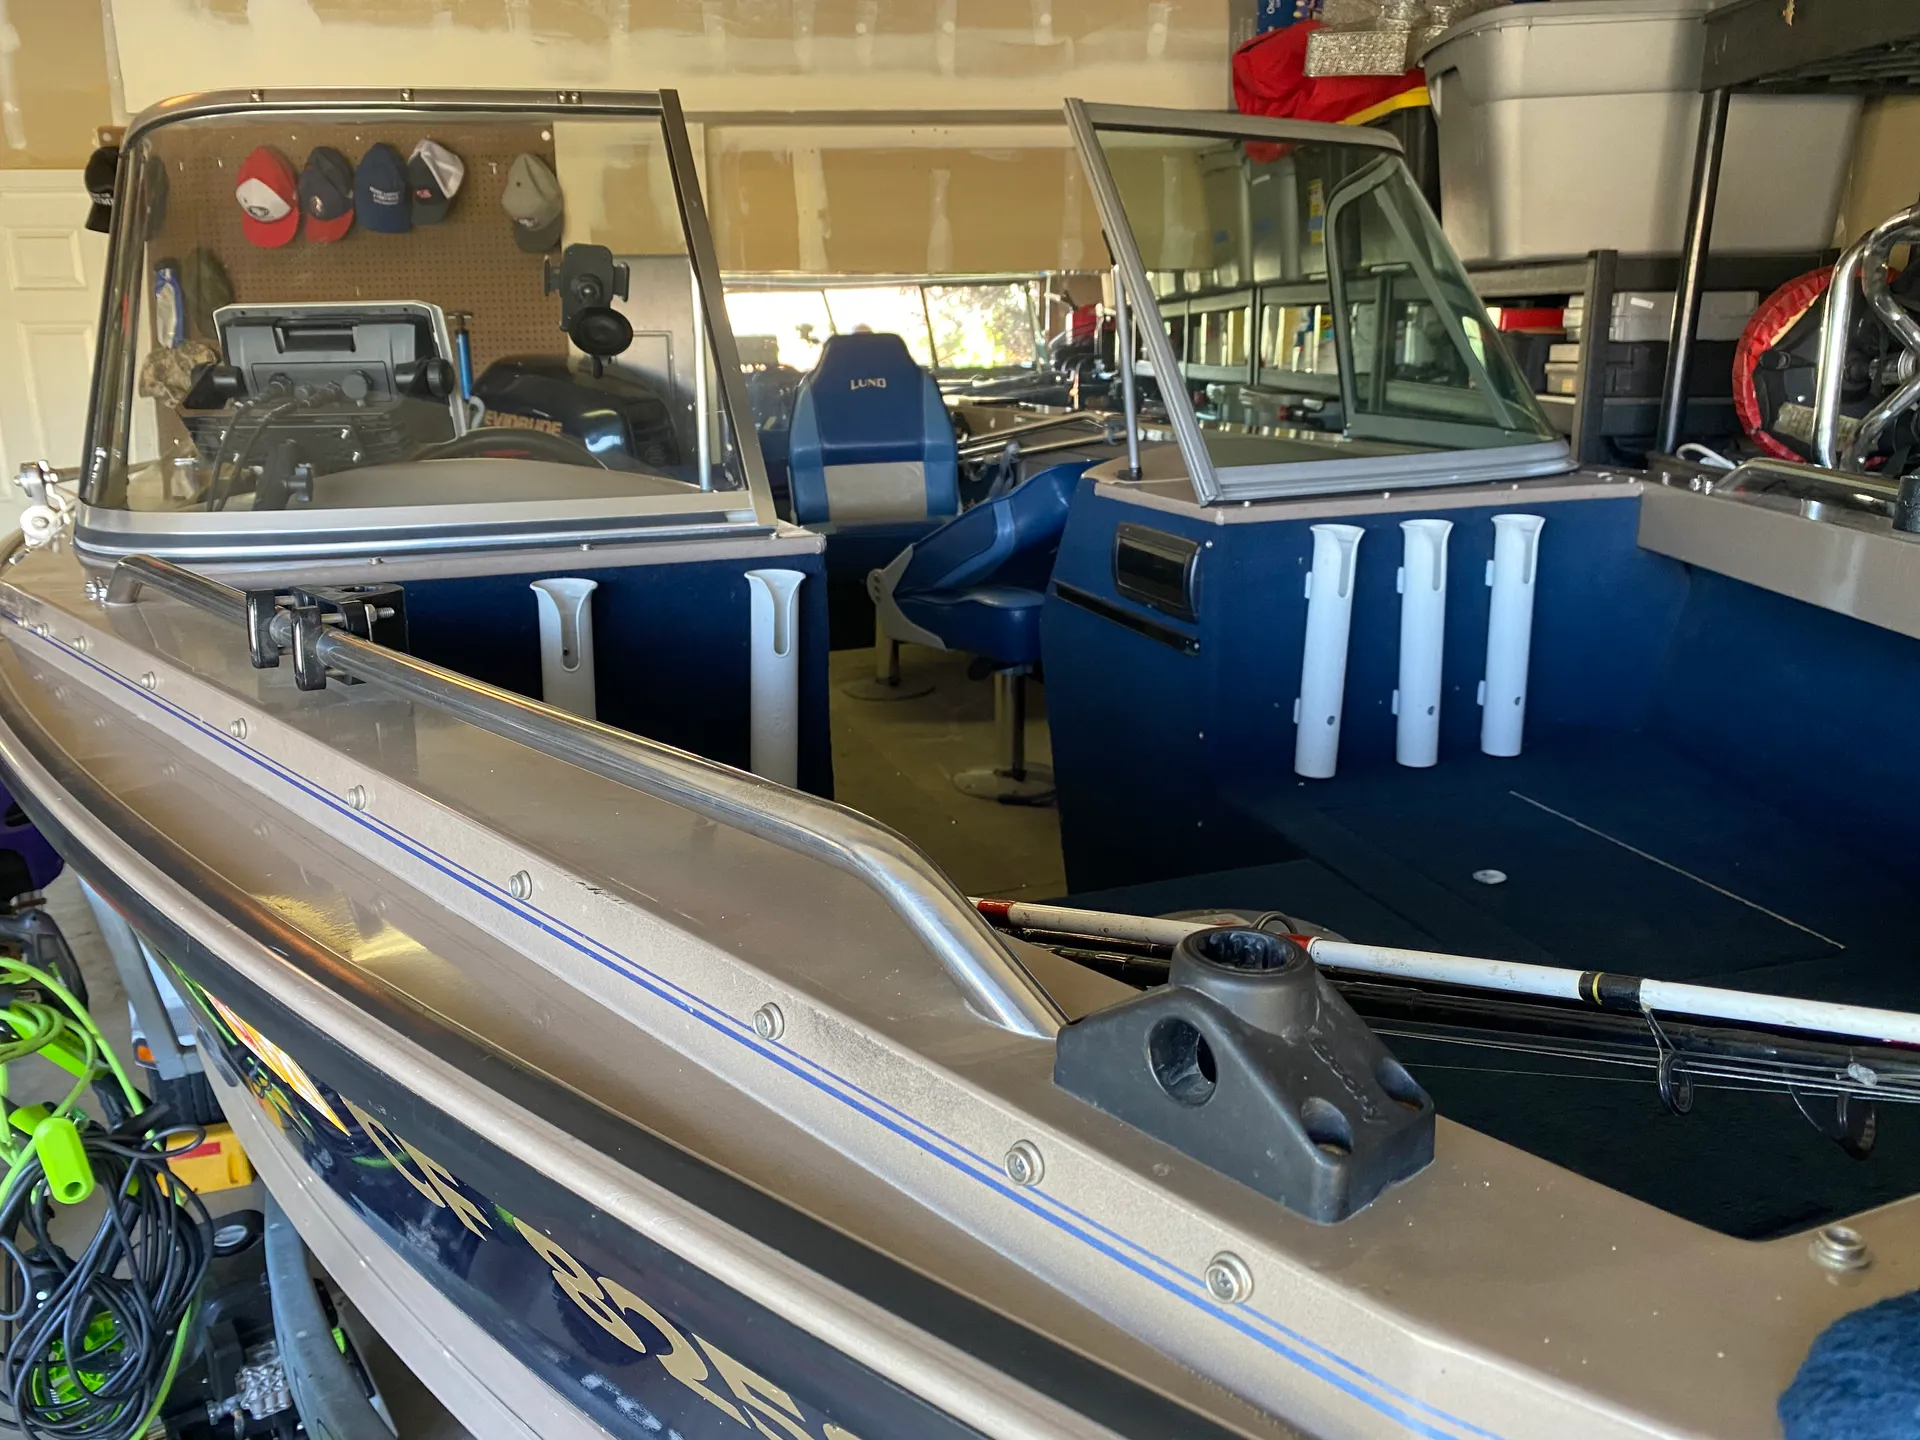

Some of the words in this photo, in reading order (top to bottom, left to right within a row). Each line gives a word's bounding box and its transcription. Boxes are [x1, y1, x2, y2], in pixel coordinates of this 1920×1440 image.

[850, 378, 887, 391] LUND
[338, 1093, 493, 1241] CF
[513, 1217, 863, 1440] 825
